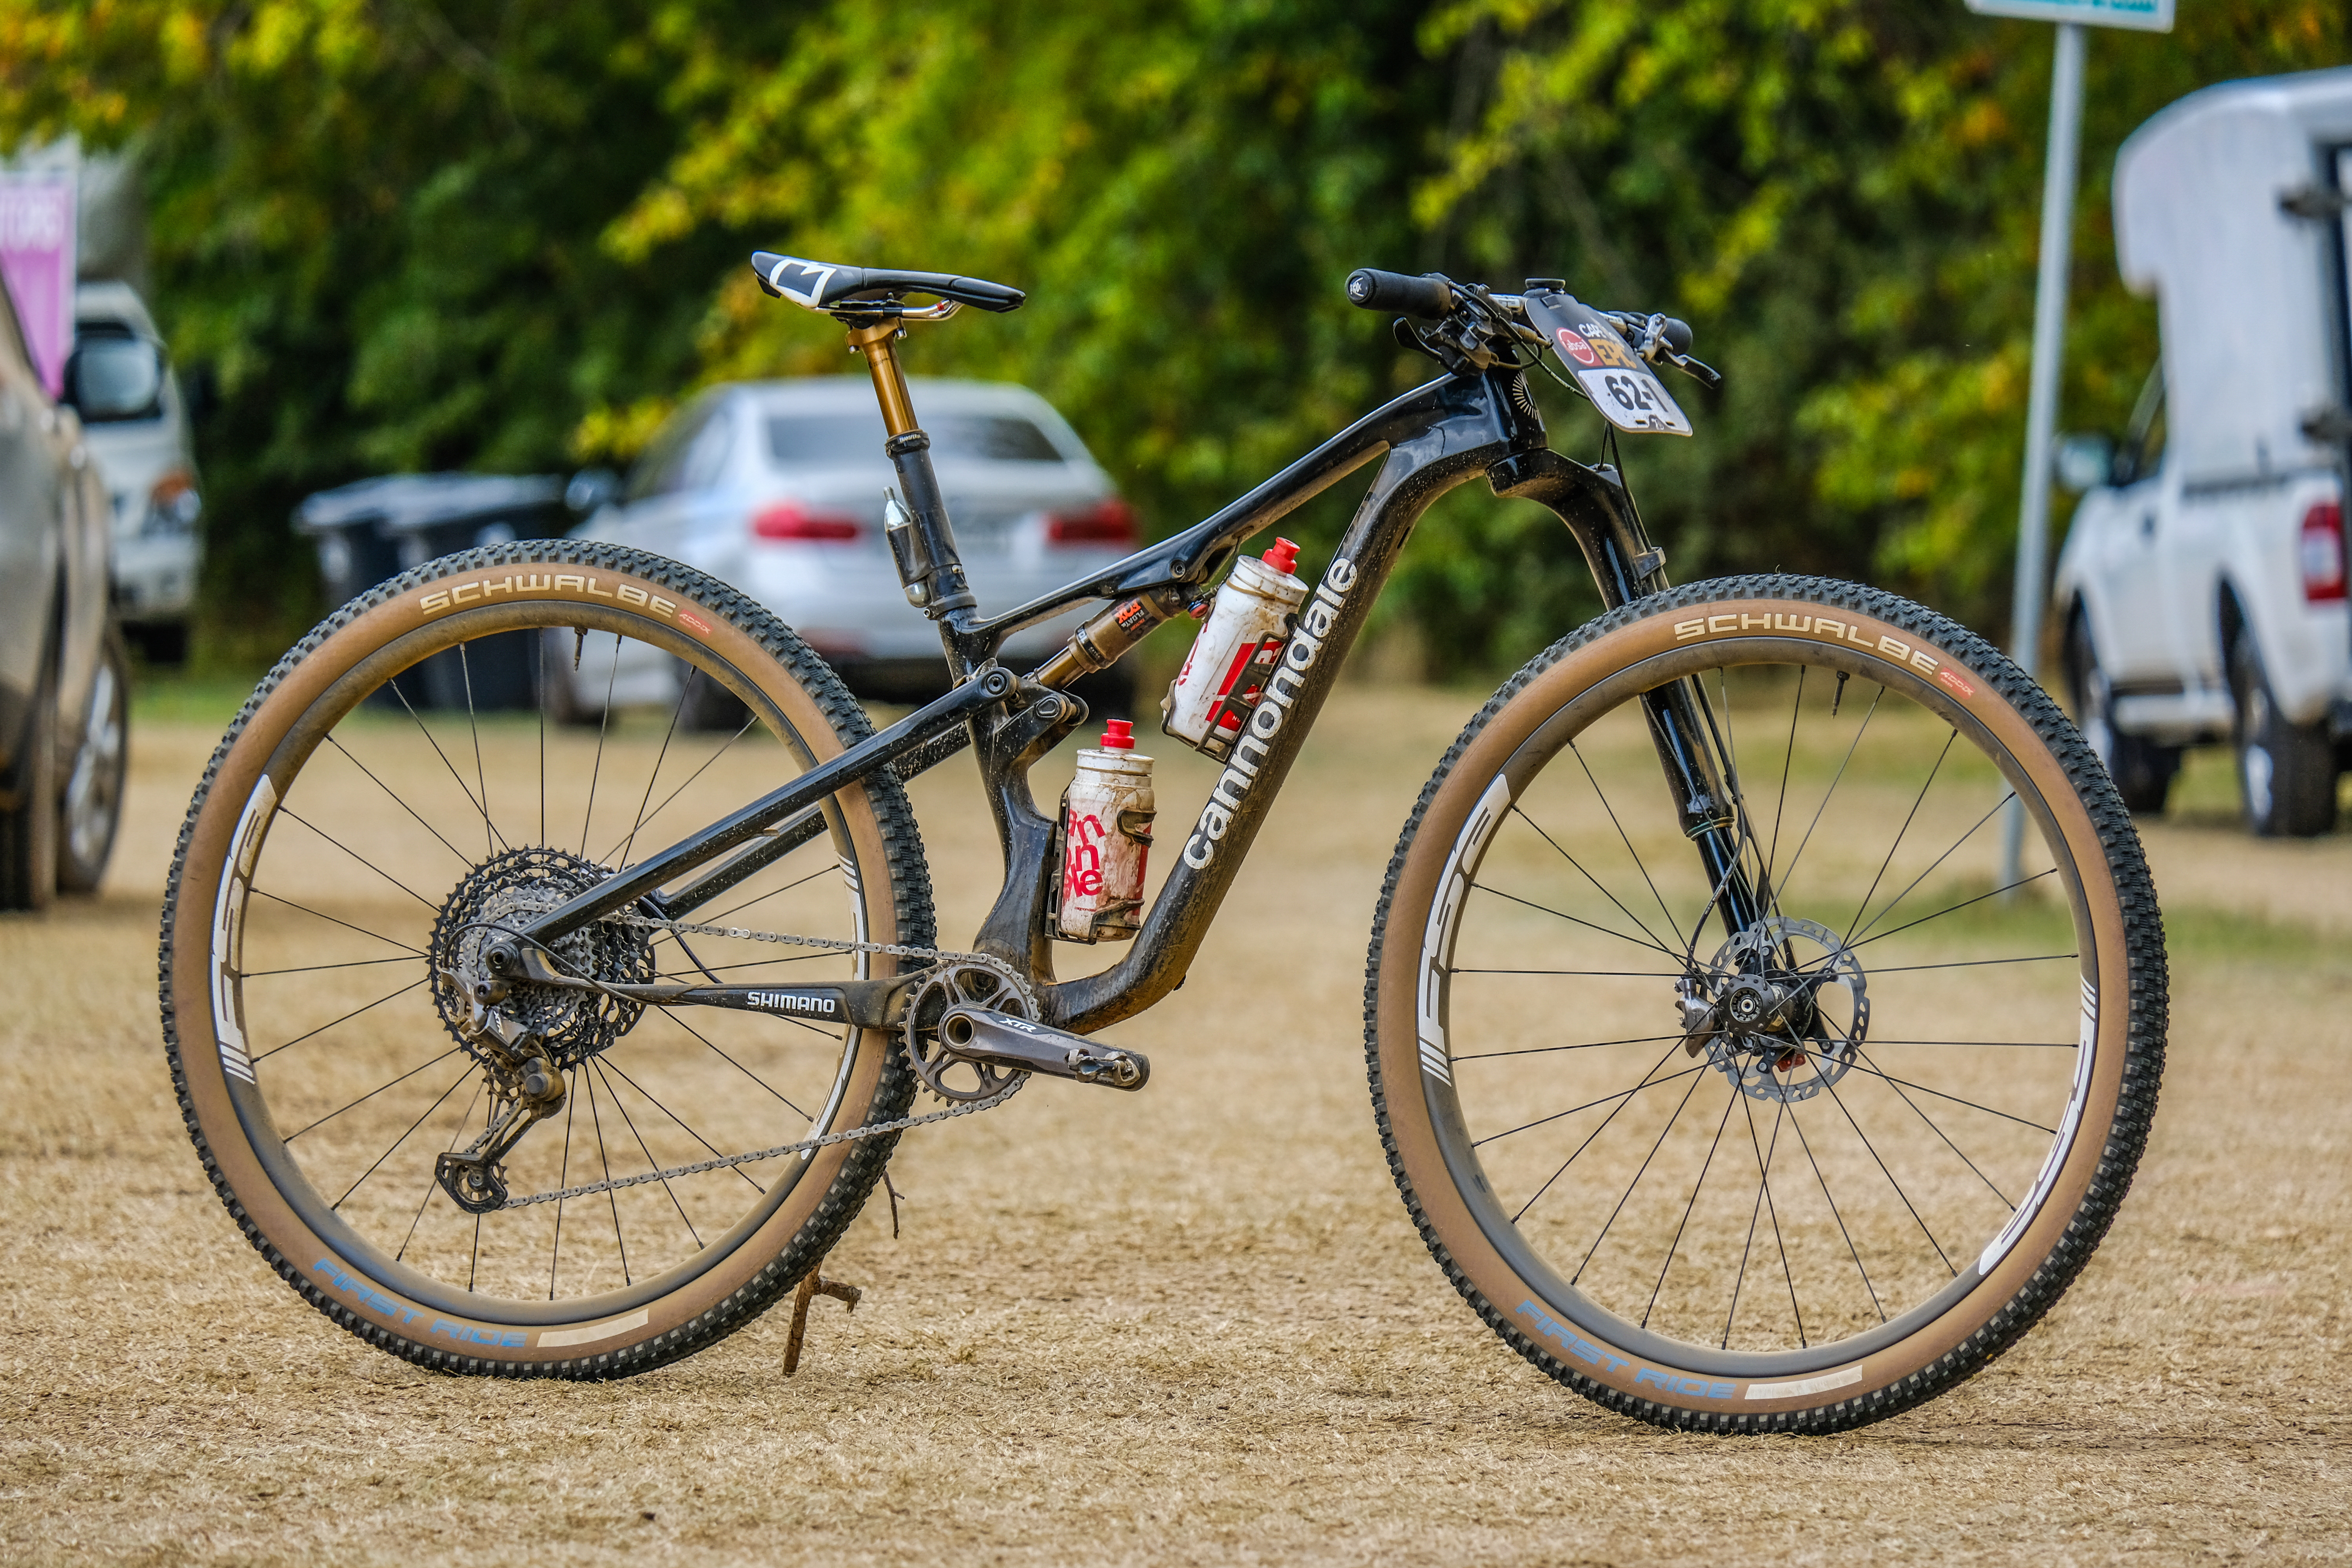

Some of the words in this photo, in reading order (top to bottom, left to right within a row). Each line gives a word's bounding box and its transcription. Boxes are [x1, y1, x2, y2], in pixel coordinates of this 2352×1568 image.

[1566, 339, 1587, 350] absa
[419, 574, 677, 619] SCHWALBE
[679, 614, 711, 634] ADDIX
[1114, 599, 1141, 624] FOX
[1125, 610, 1145, 627] FLOAT
[1674, 613, 1939, 676] SCHWALBE
[1940, 672, 1974, 696] ADDIX
[1183, 557, 1358, 870] cannondale
[747, 991, 835, 1013] SHIMANO
[493, 1010, 504, 1035] XTR
[999, 1018, 1037, 1033] XTR
[314, 1258, 424, 1324] FIRST
[430, 1318, 528, 1348] RIDE
[1515, 1299, 1630, 1373] FIRST
[1635, 1368, 1737, 1400] RIDE
